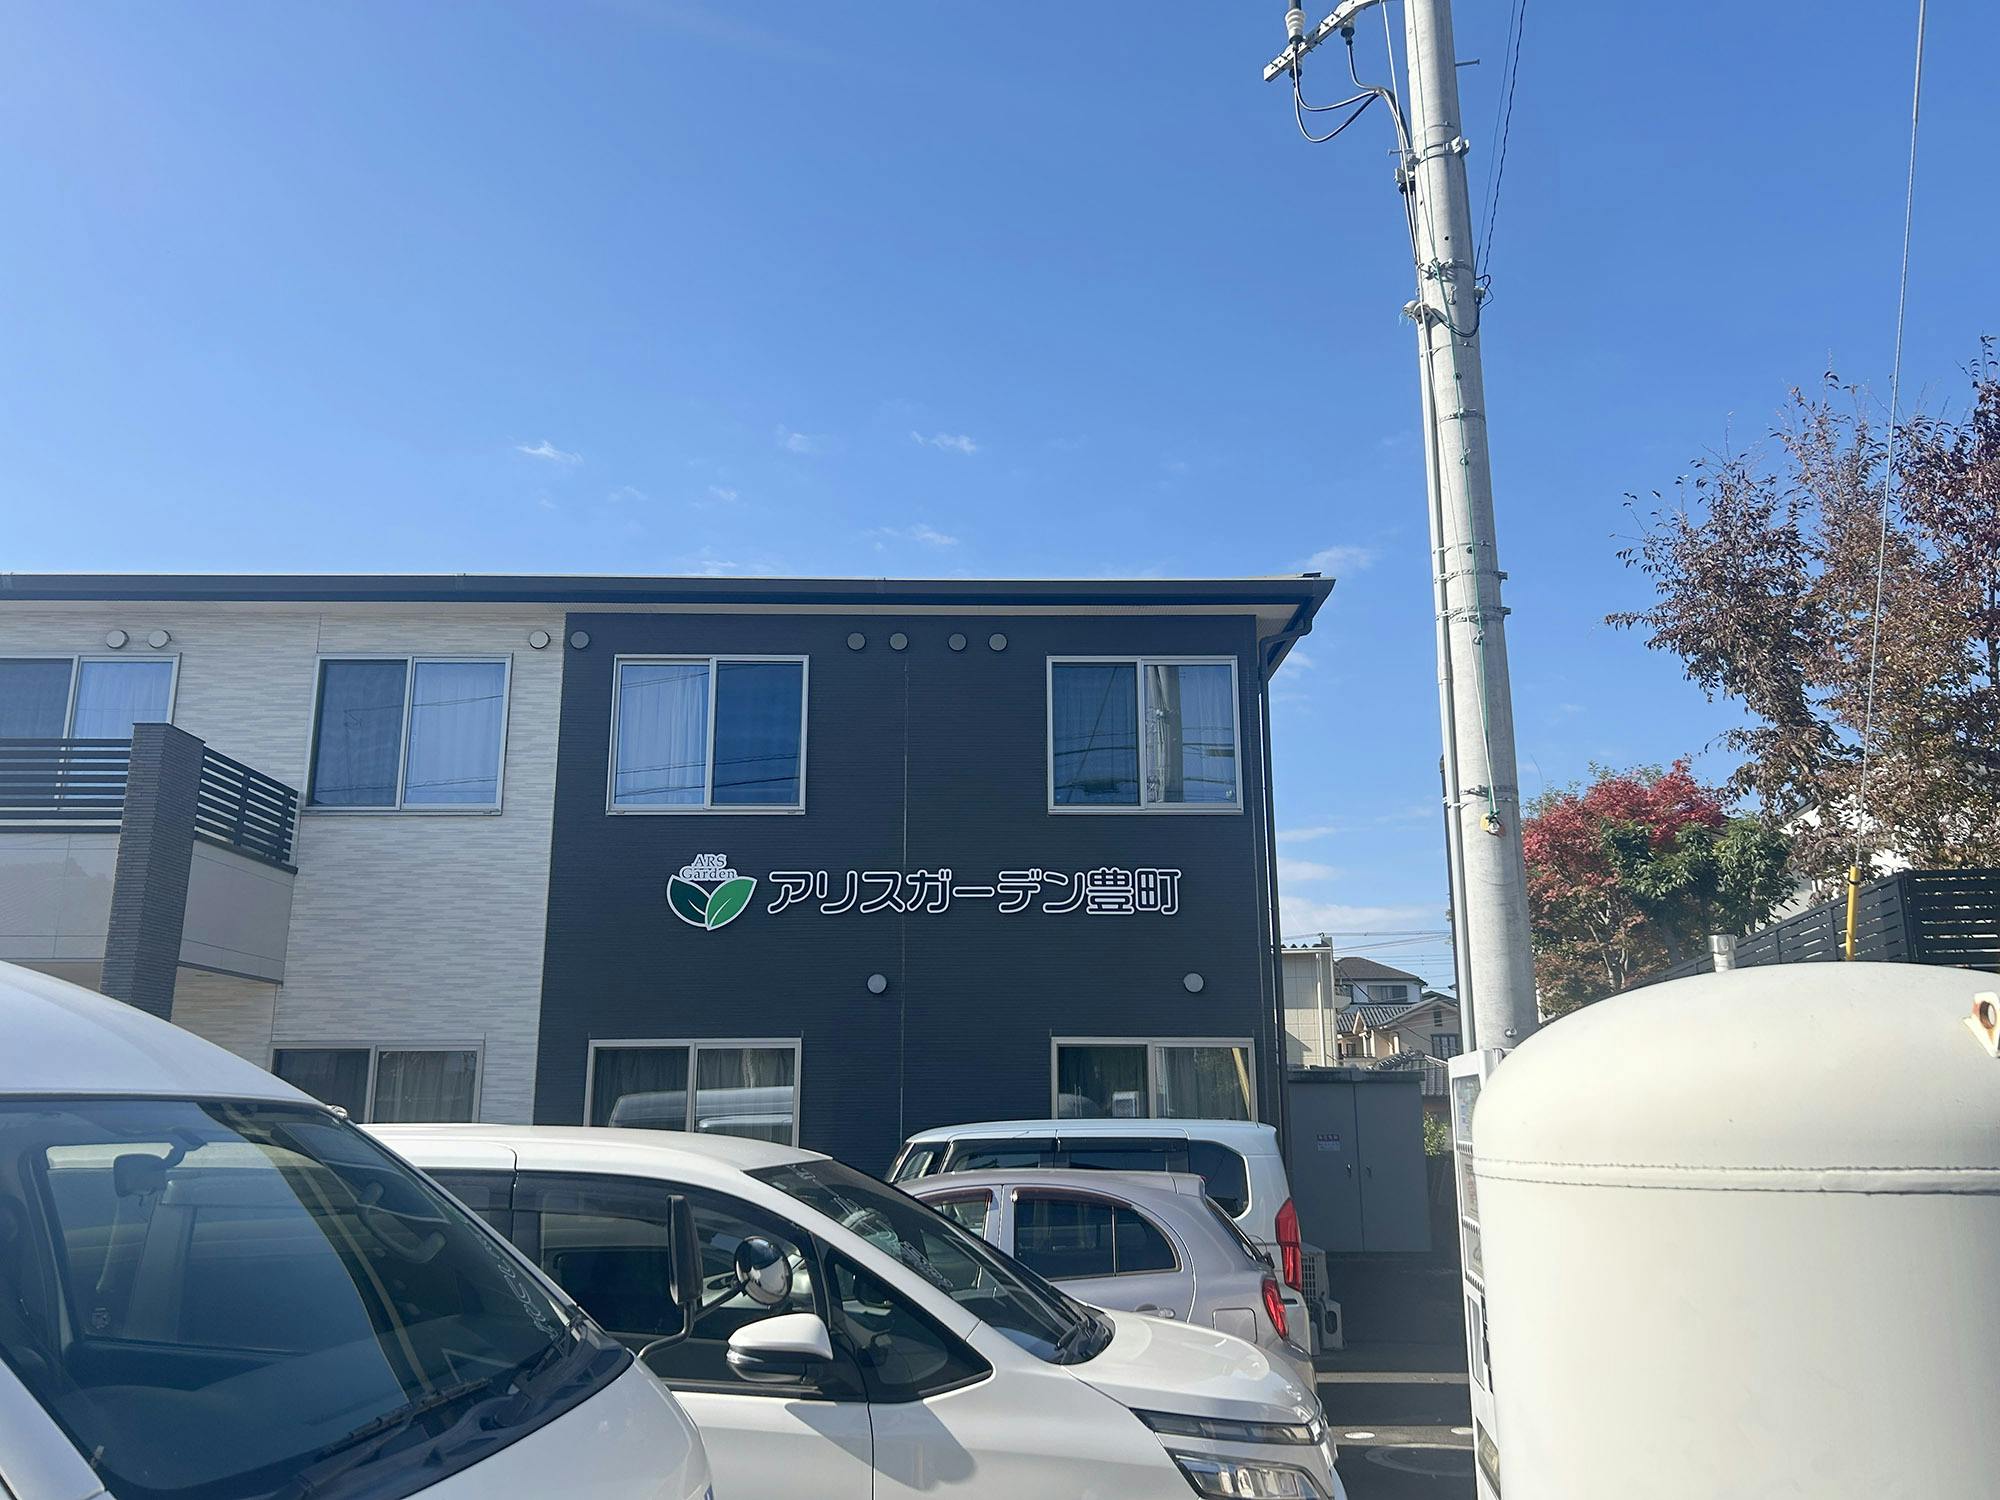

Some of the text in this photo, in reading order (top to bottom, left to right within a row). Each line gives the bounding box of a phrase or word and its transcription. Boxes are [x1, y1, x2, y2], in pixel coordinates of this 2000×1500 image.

[693, 853, 727, 868] ARS
[680, 866, 737, 880] Garden
[768, 869, 1180, 915] アリスガーデン豊町
